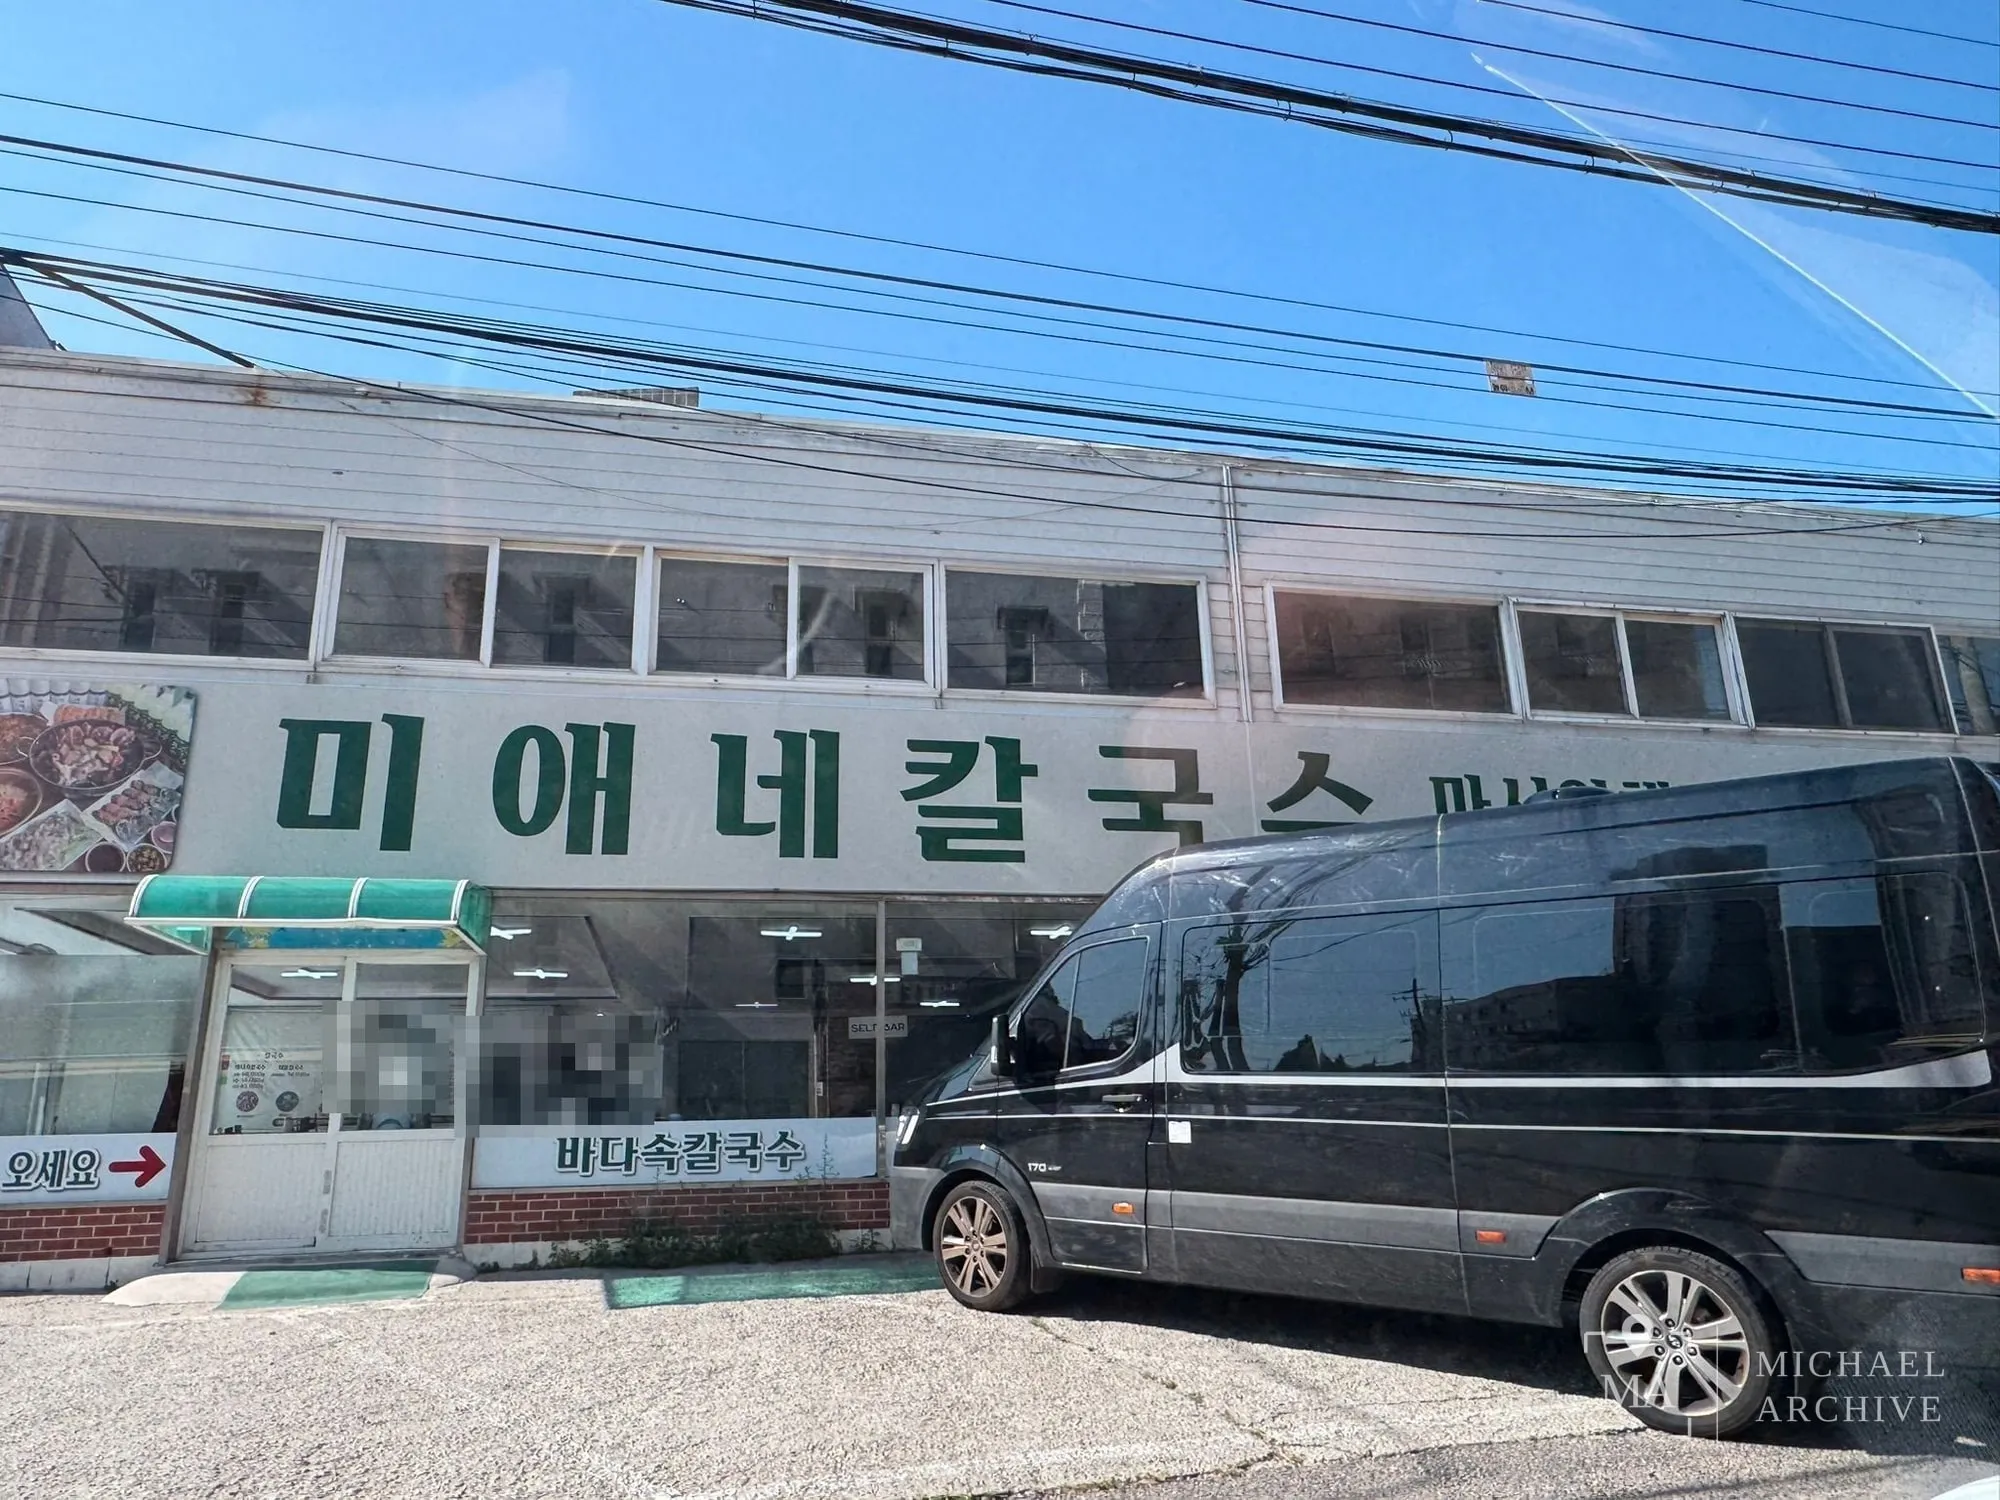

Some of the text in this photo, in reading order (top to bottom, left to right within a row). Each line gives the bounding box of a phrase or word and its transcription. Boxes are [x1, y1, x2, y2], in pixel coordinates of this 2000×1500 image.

[277, 713, 1374, 862] 미애네칼국수
[1, 1149, 98, 1189] 오세요
[556, 1130, 804, 1176] 바다속칼국수
[1027, 1162, 1047, 1172] 170
